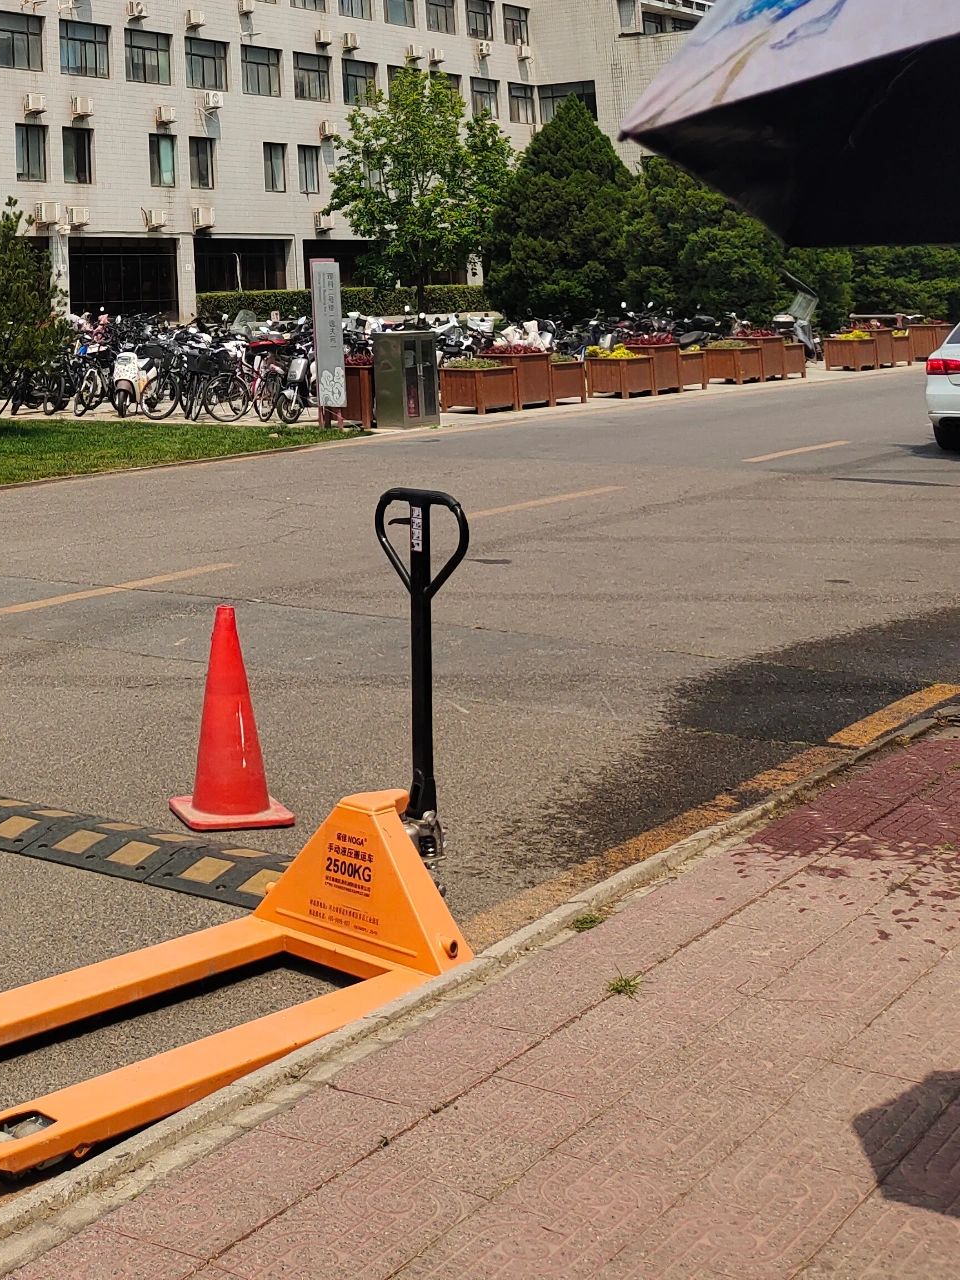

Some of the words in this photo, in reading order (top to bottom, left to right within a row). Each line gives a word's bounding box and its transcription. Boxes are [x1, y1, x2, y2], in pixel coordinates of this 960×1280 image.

[347, 835, 365, 847] NOGA
[327, 842, 374, 864] 手动液压搬运车
[325, 857, 372, 883] 2500KG
